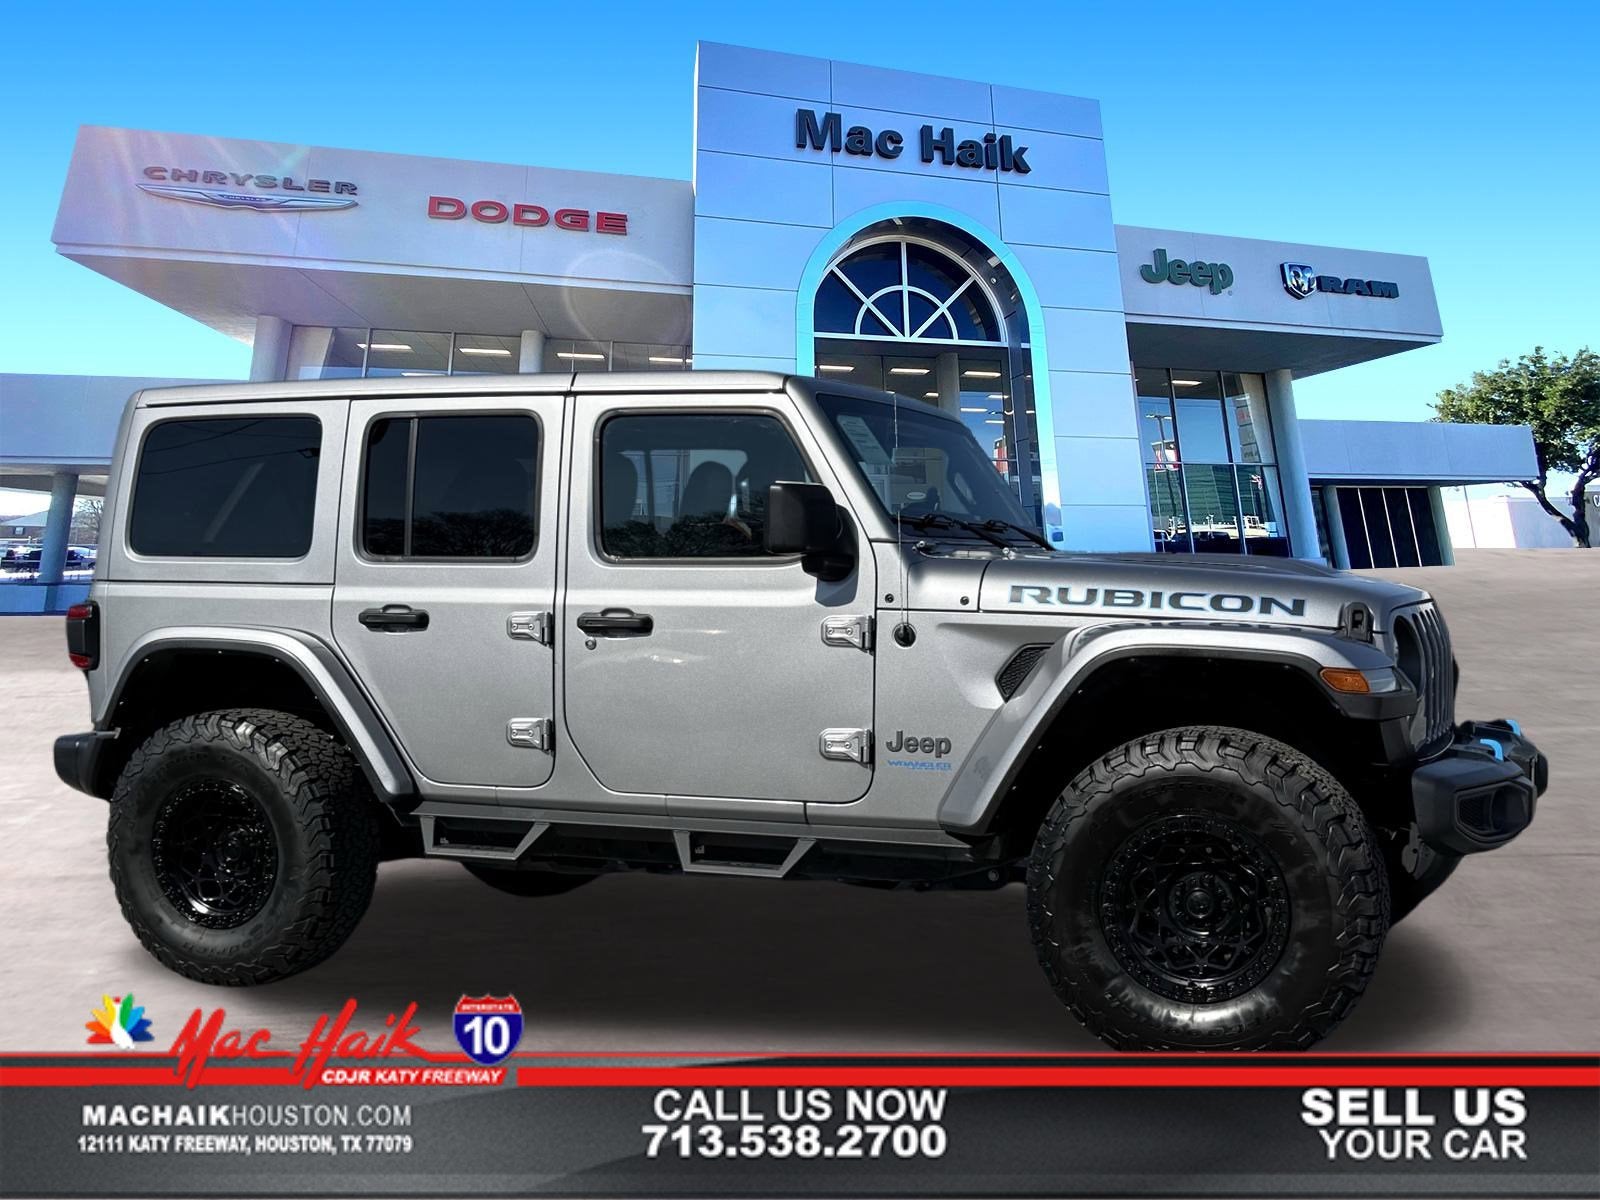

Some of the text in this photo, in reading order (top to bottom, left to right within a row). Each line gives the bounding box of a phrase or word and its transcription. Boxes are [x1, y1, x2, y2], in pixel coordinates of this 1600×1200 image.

[796, 108, 1032, 174] Mac Haik
[143, 165, 359, 196] CHRYSLER
[428, 196, 628, 236] DODGE
[1140, 248, 1234, 295] Jeep
[1317, 275, 1399, 298] RAM
[1009, 585, 1306, 617] RUBICON
[886, 730, 952, 758] Jeep
